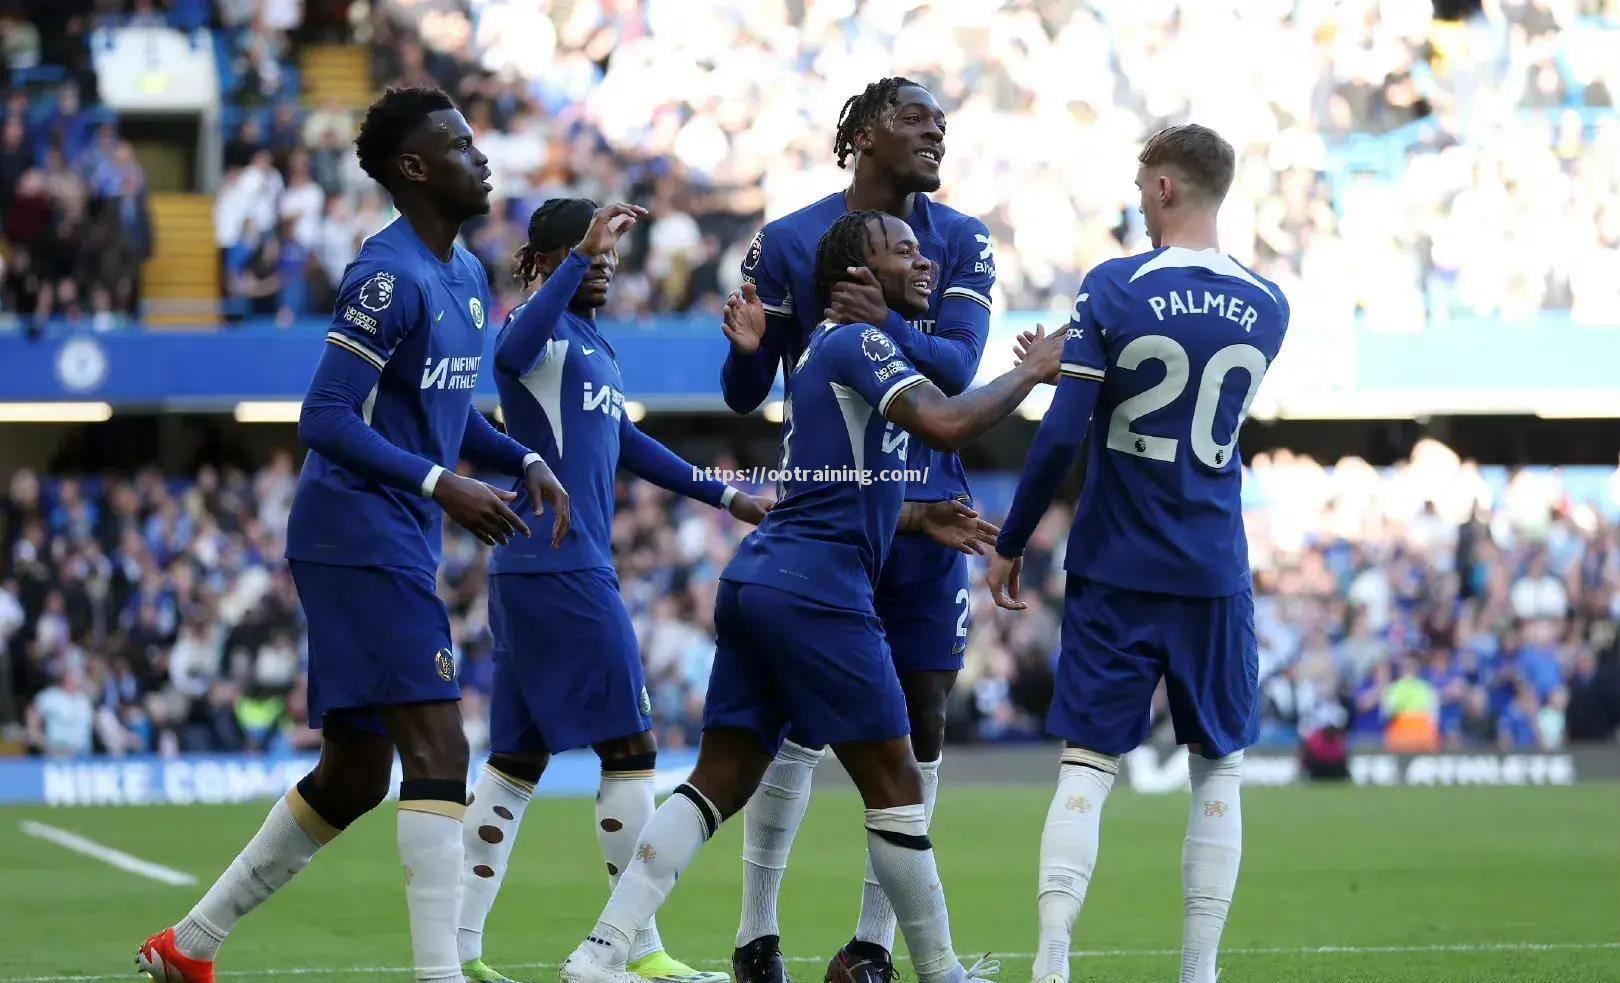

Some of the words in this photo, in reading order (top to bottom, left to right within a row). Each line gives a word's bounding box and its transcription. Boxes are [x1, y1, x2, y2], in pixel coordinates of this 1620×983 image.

[1149, 290, 1258, 333] PALMER
[1106, 334, 1267, 469] 20
[955, 588, 969, 637] 2
